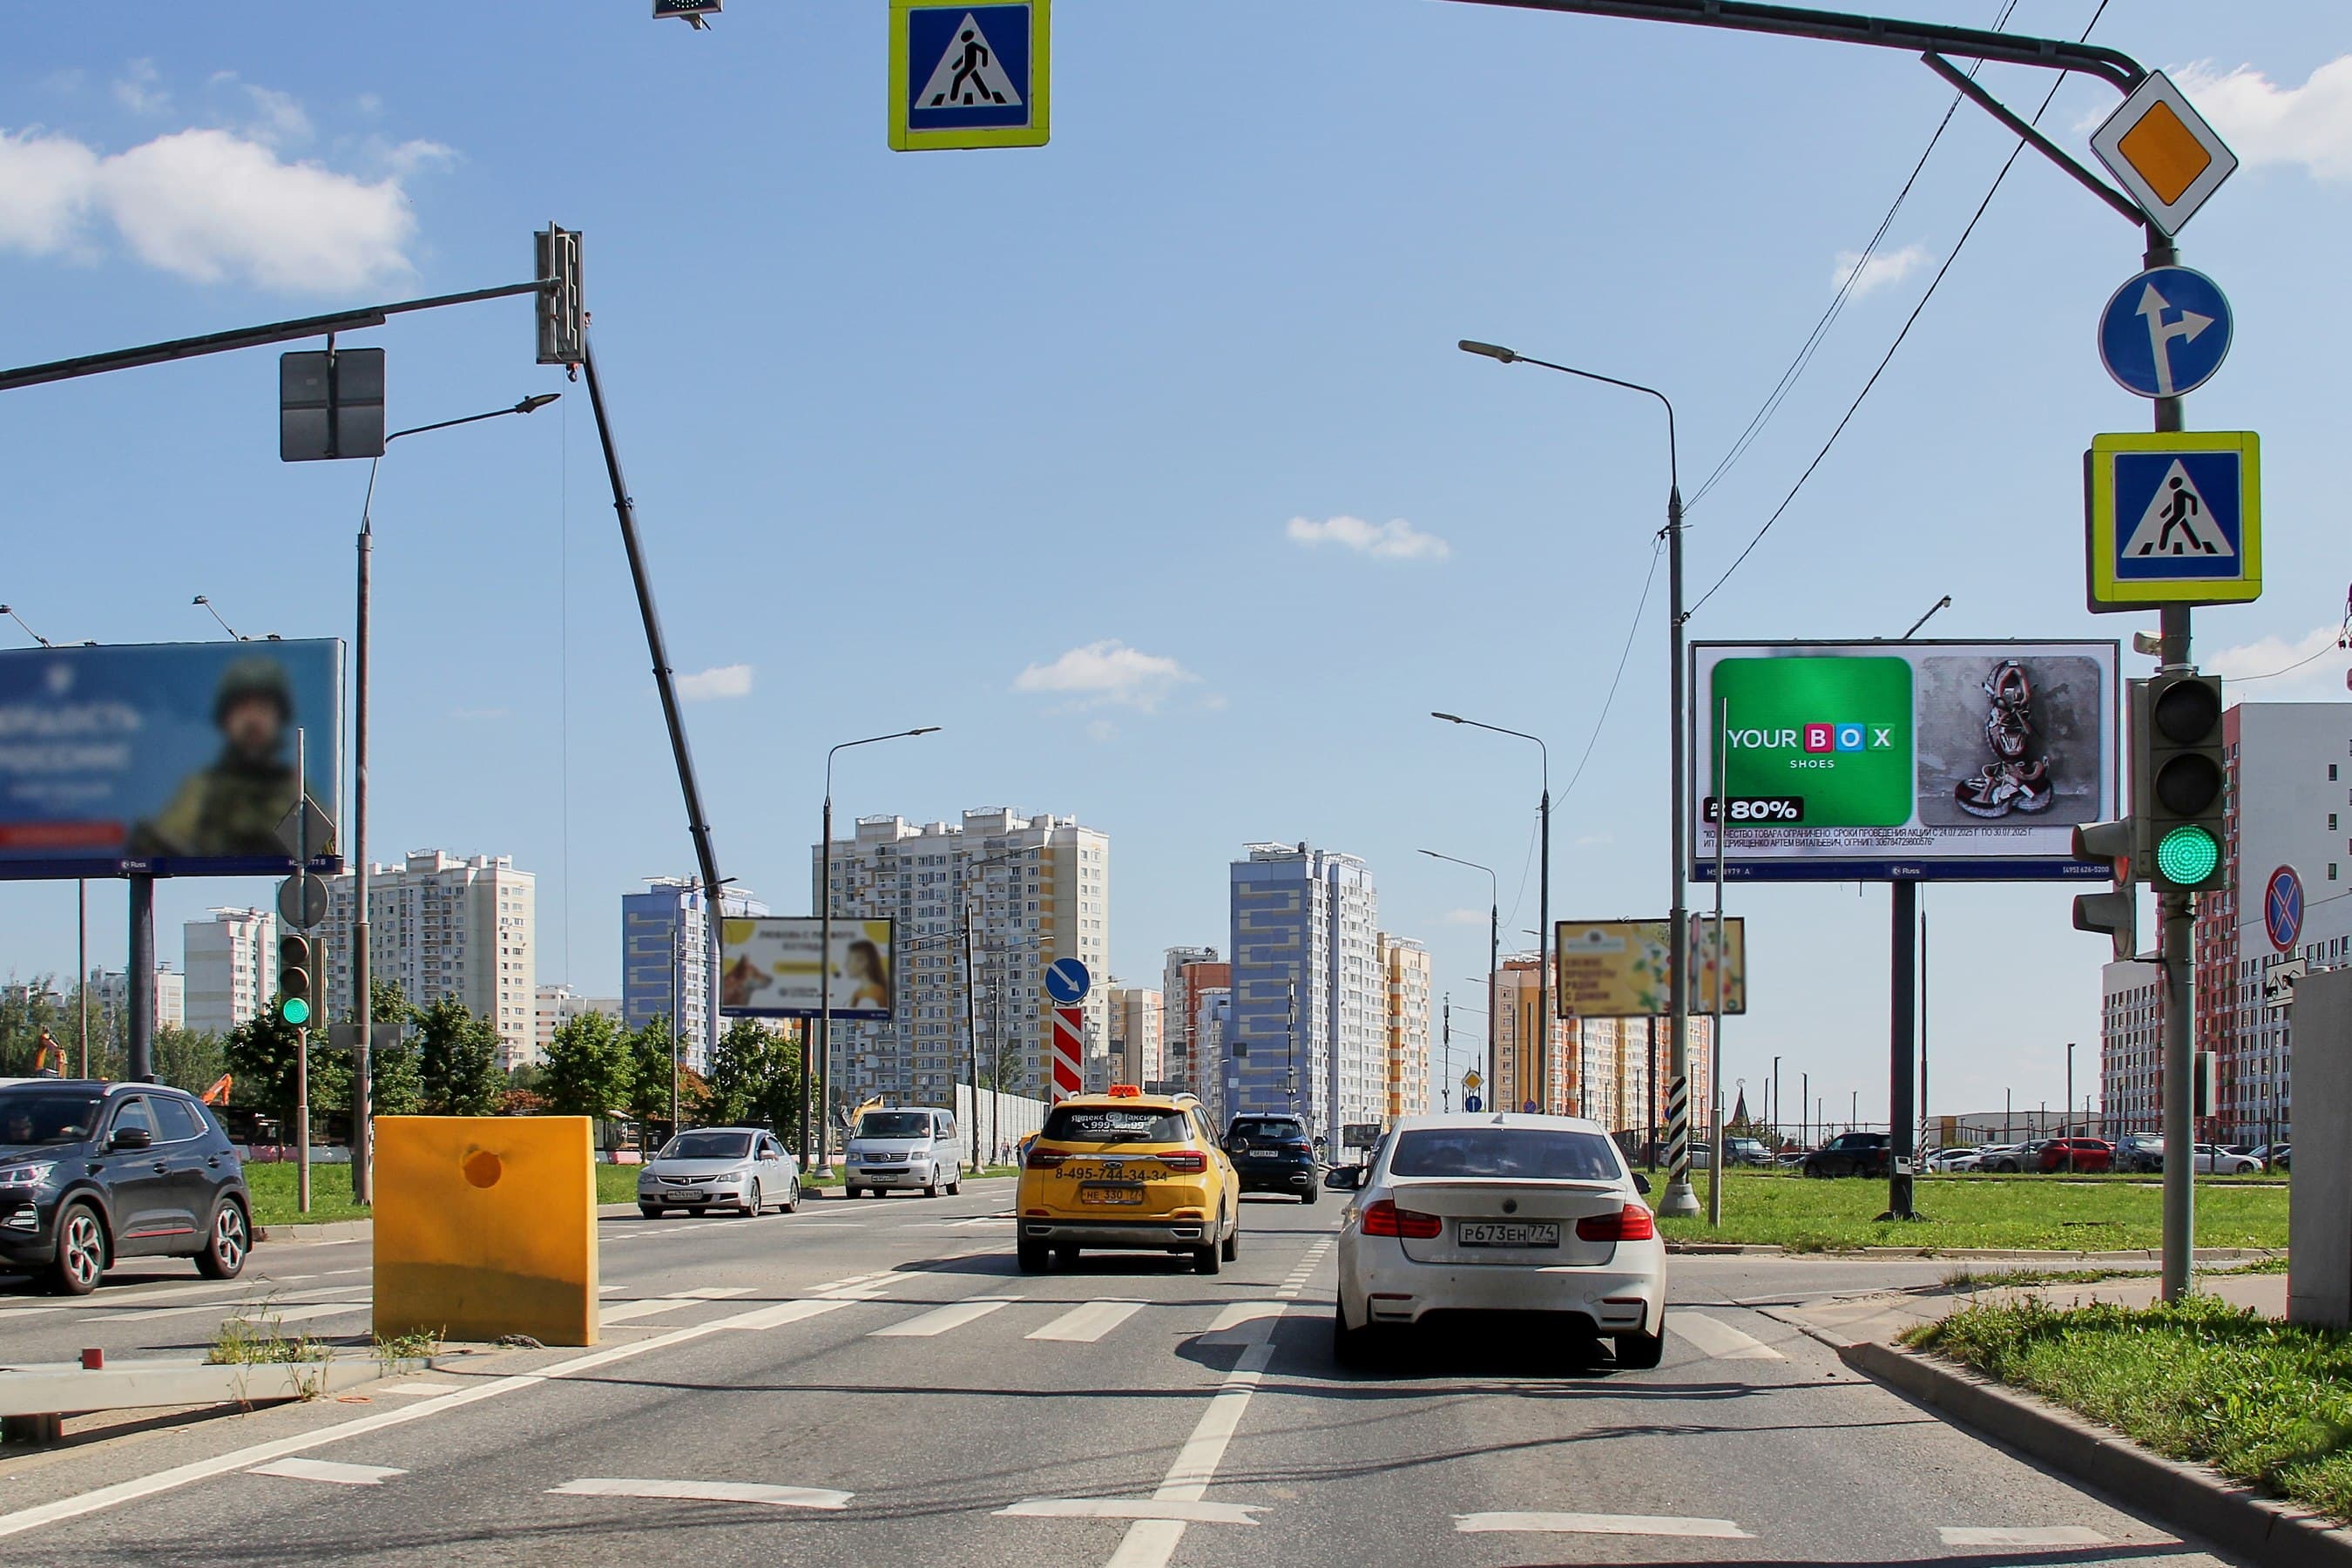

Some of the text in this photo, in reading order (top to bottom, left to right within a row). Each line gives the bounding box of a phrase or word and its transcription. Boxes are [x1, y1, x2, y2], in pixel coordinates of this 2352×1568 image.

[1727, 728, 1891, 748] YOUR BOX
[1790, 760, 1835, 768] SHOES
[1731, 801, 1798, 819] 80%
[1754, 829, 1782, 838] ТОВАРА
[1859, 828, 1907, 837] ПРОВЕДЕНИЯ
[1908, 828, 1931, 837] АКЦИИ
[1703, 839, 1714, 848] ИП
[1770, 839, 1794, 848] АРТЕМ
[1055, 1167, 1168, 1181] 8-495-744-34-34
[1104, 1190, 1123, 1200] 330
